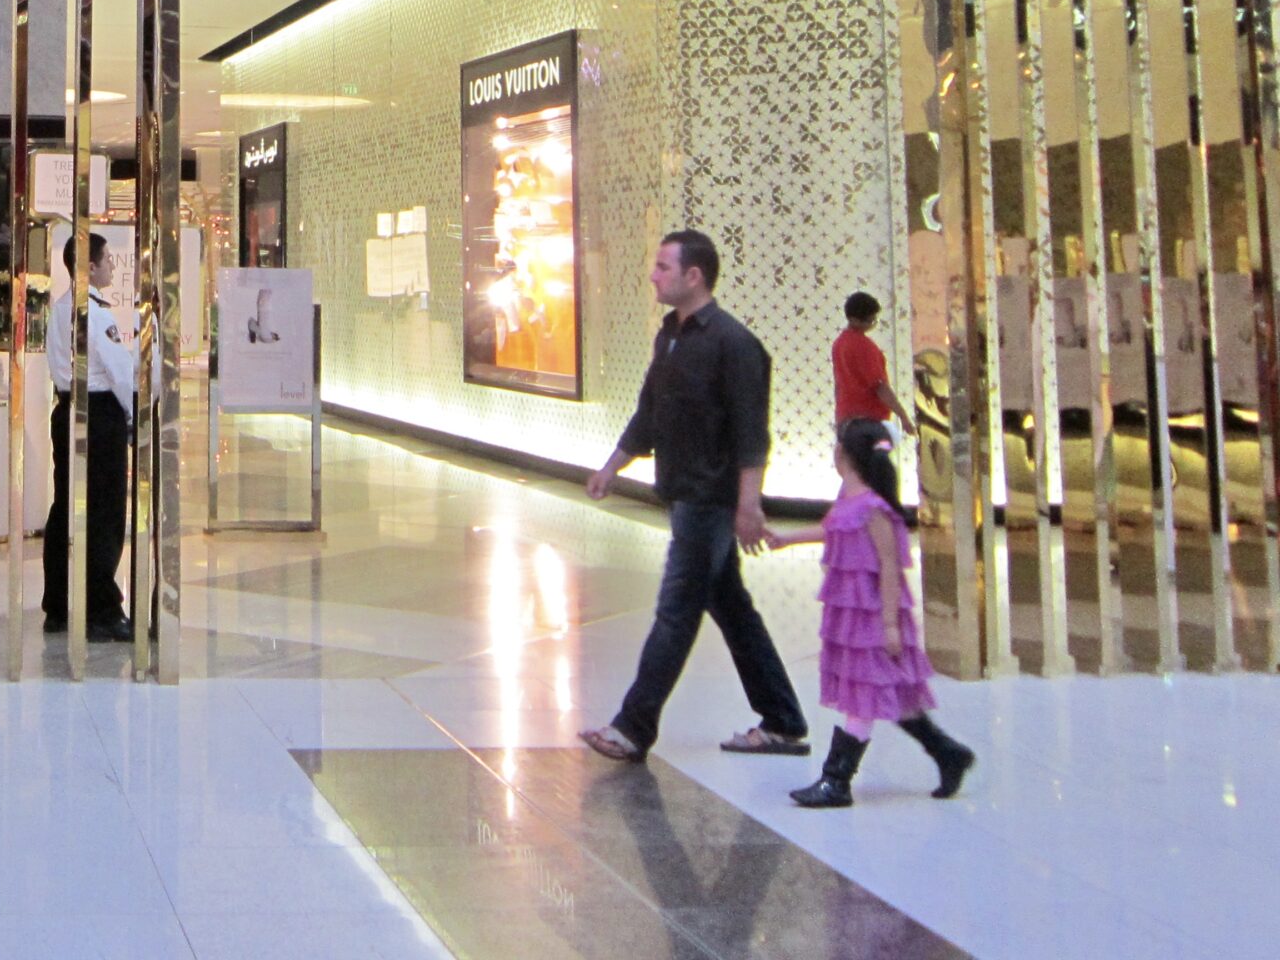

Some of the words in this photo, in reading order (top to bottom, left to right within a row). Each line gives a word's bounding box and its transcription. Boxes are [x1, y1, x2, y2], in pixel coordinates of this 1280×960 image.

[469, 72, 502, 106] LOUIS
[505, 56, 560, 97] VUITTON
[281, 382, 305, 400] level
